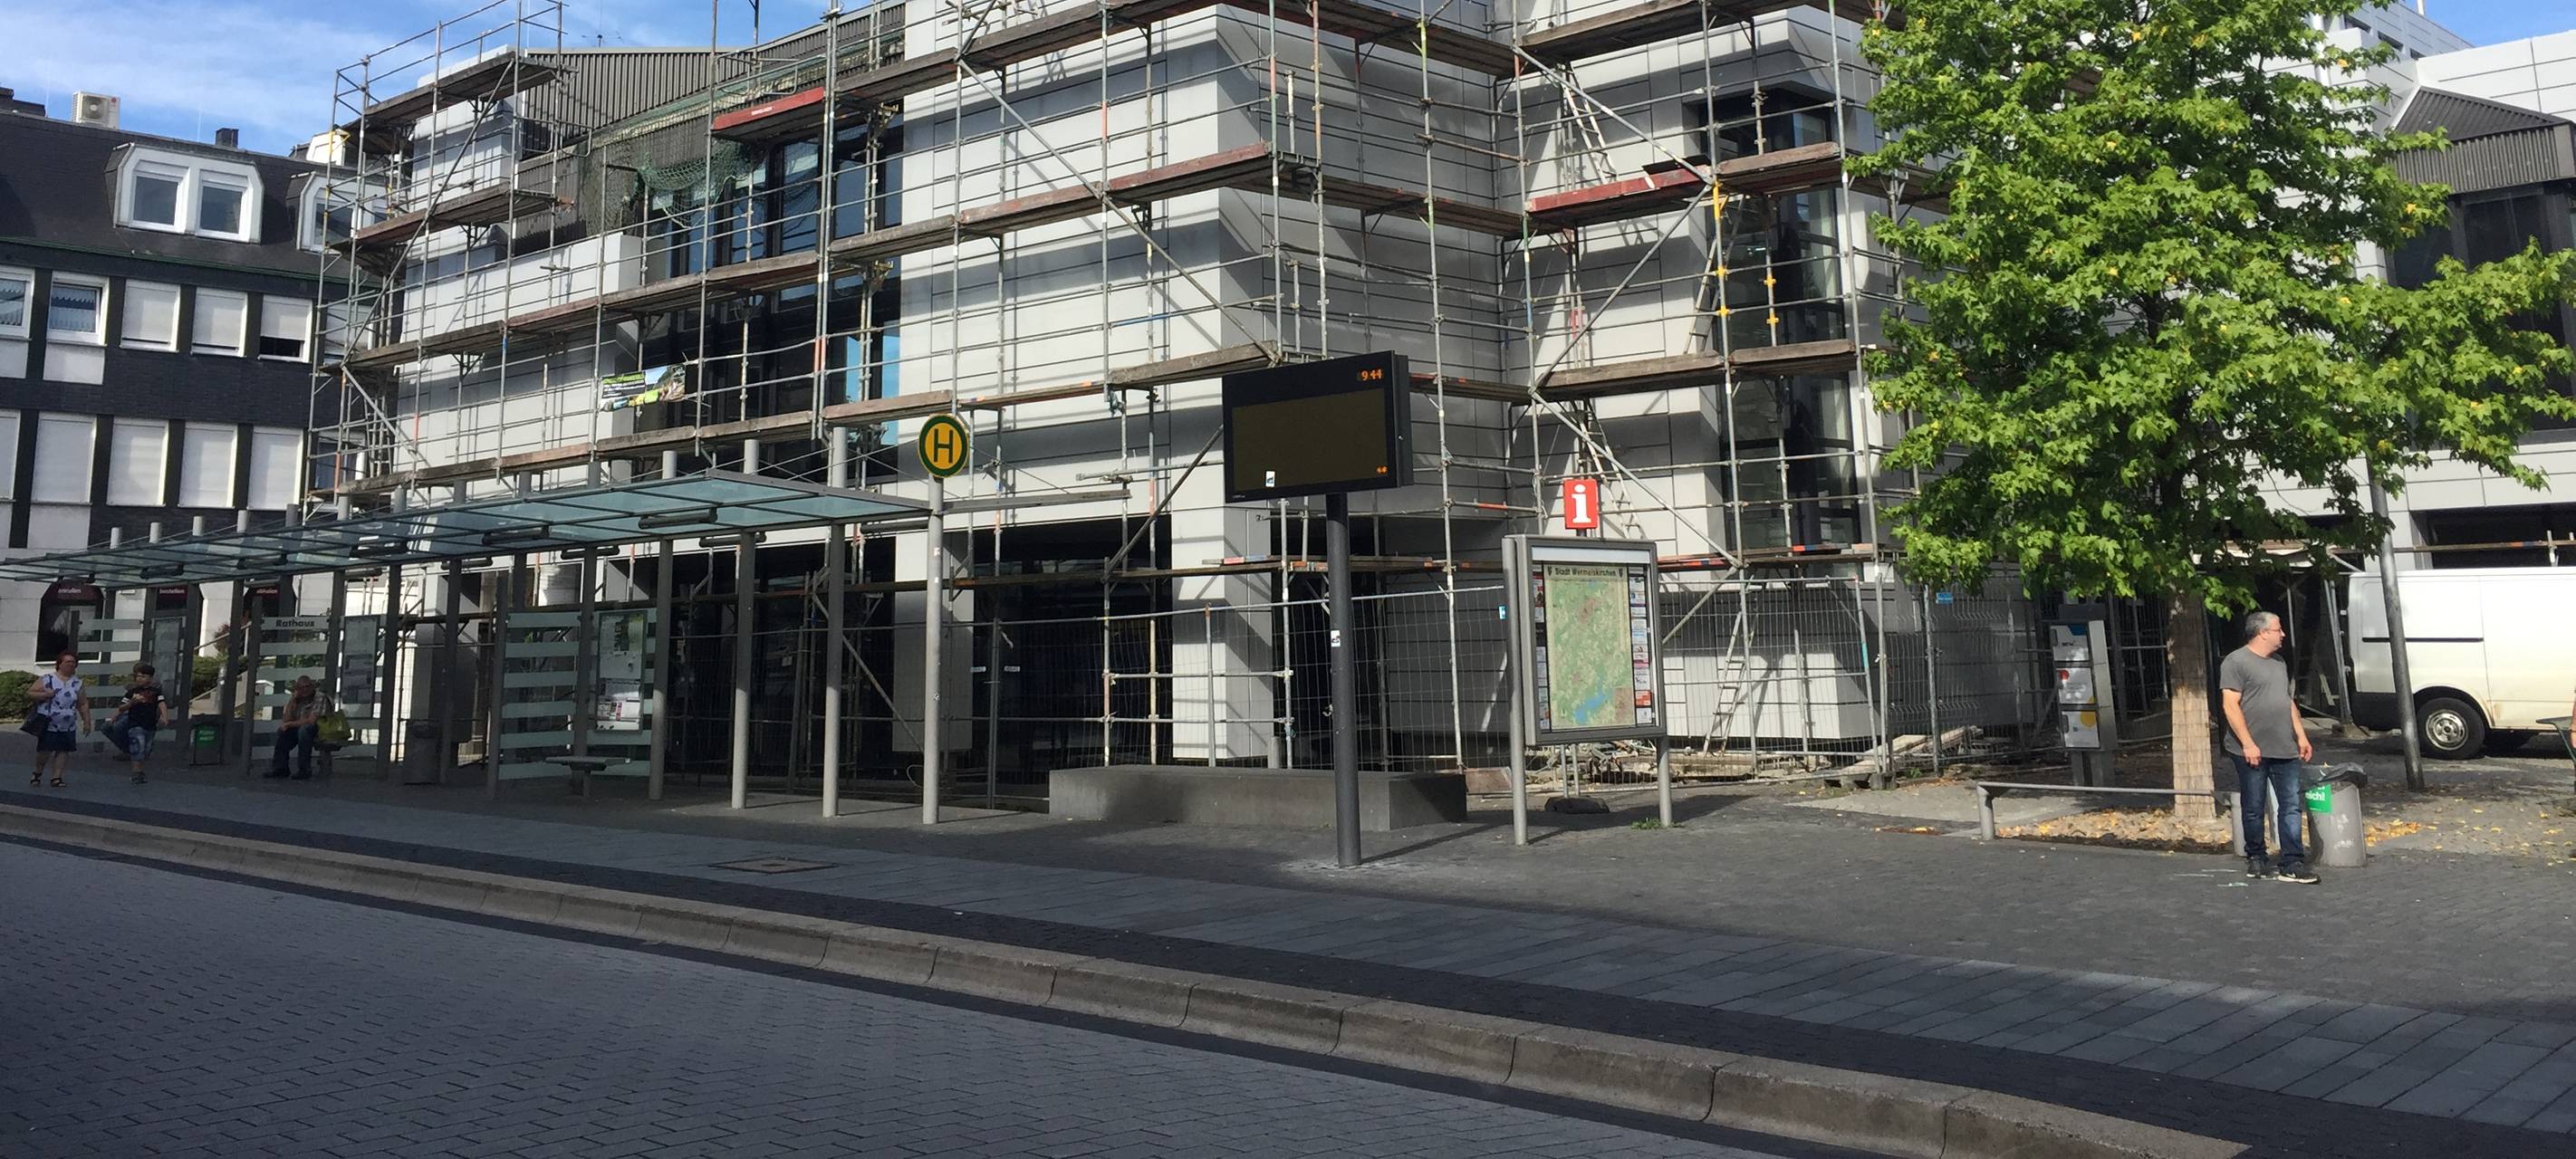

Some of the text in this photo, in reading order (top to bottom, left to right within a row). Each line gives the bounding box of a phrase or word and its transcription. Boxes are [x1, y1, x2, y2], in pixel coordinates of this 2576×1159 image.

[934, 428, 954, 464] H
[1572, 484, 1592, 523] i
[1554, 567, 1572, 576] Stadt
[275, 619, 315, 627] Rathaus
